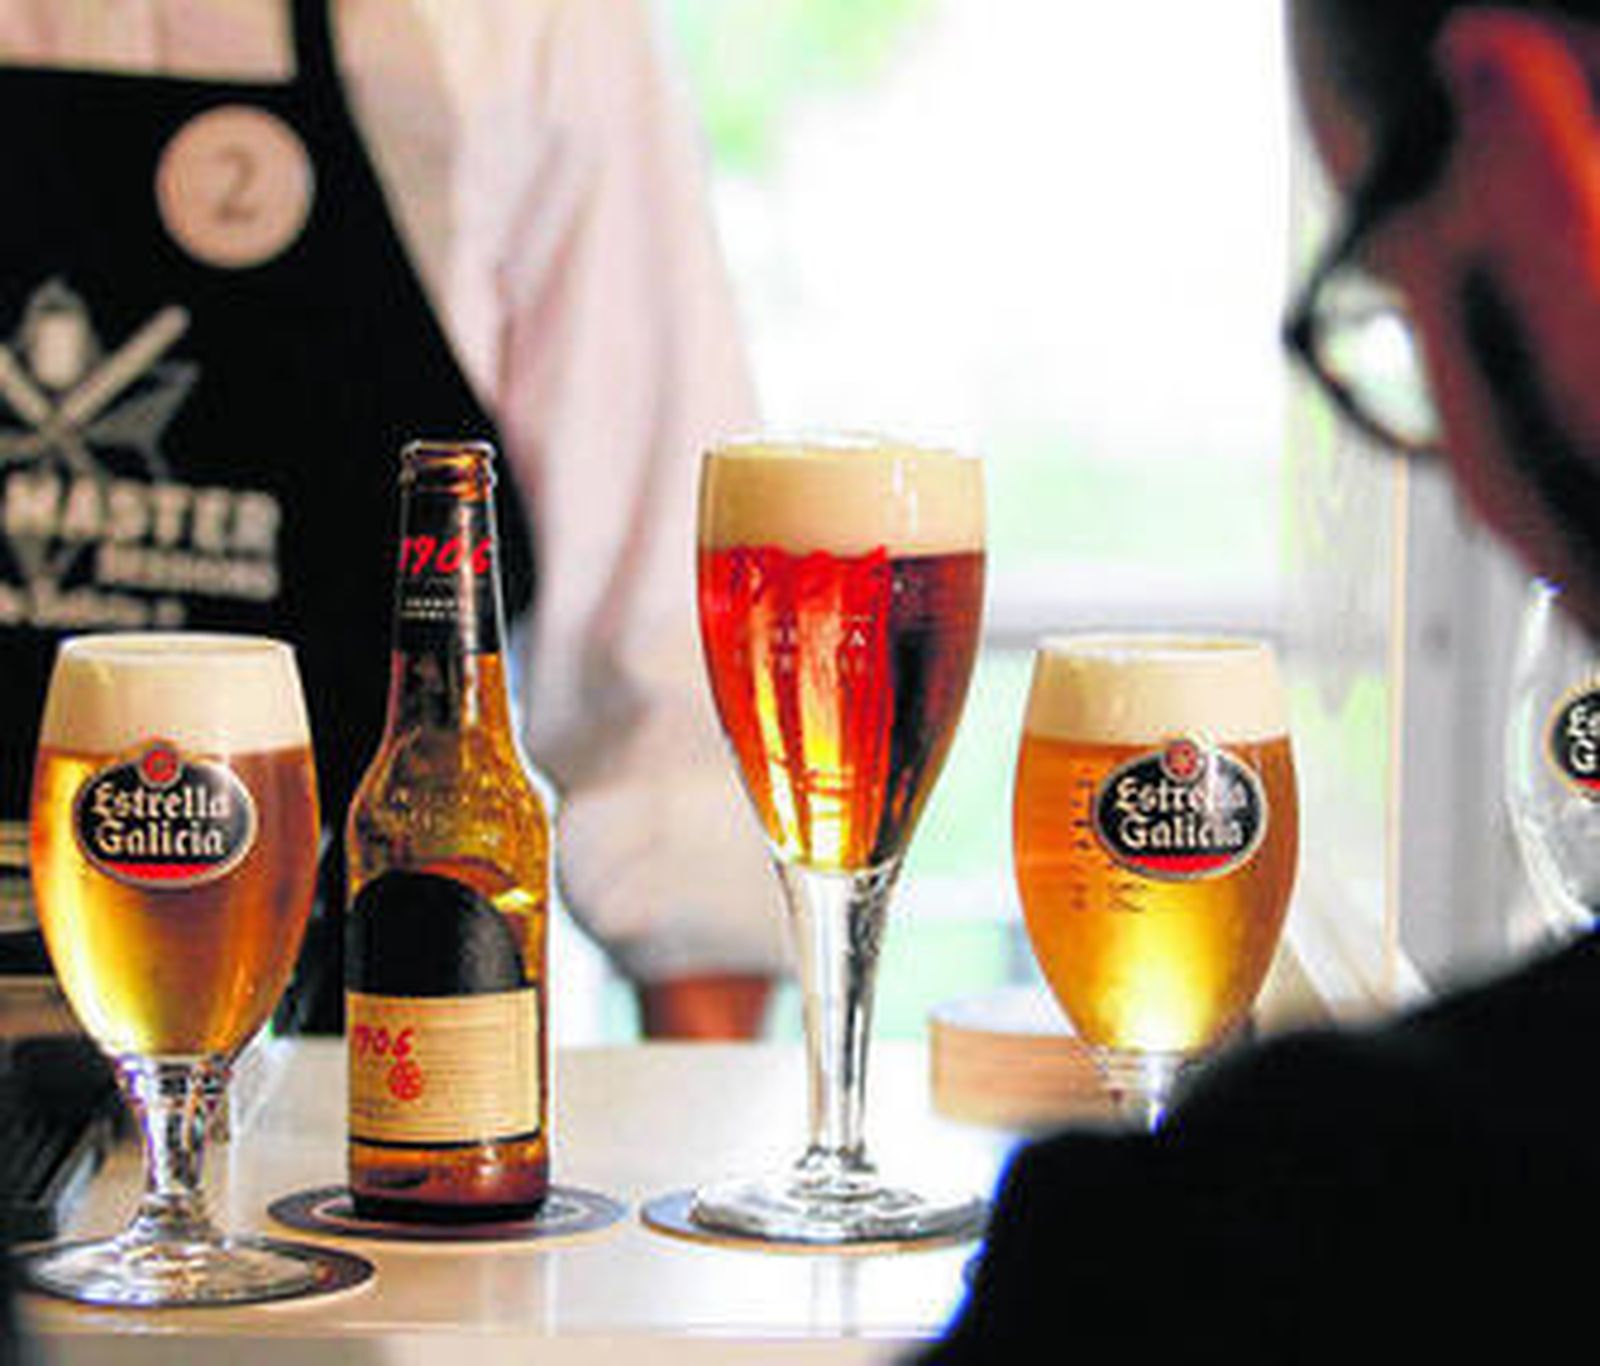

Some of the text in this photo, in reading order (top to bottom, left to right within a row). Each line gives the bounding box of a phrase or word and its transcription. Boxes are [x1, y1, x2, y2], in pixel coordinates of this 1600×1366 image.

[213, 145, 260, 225] 2
[4, 471, 280, 551] MASTER
[398, 535, 492, 575] 1906
[93, 782, 232, 820] Estrella
[96, 820, 226, 857] Galicia
